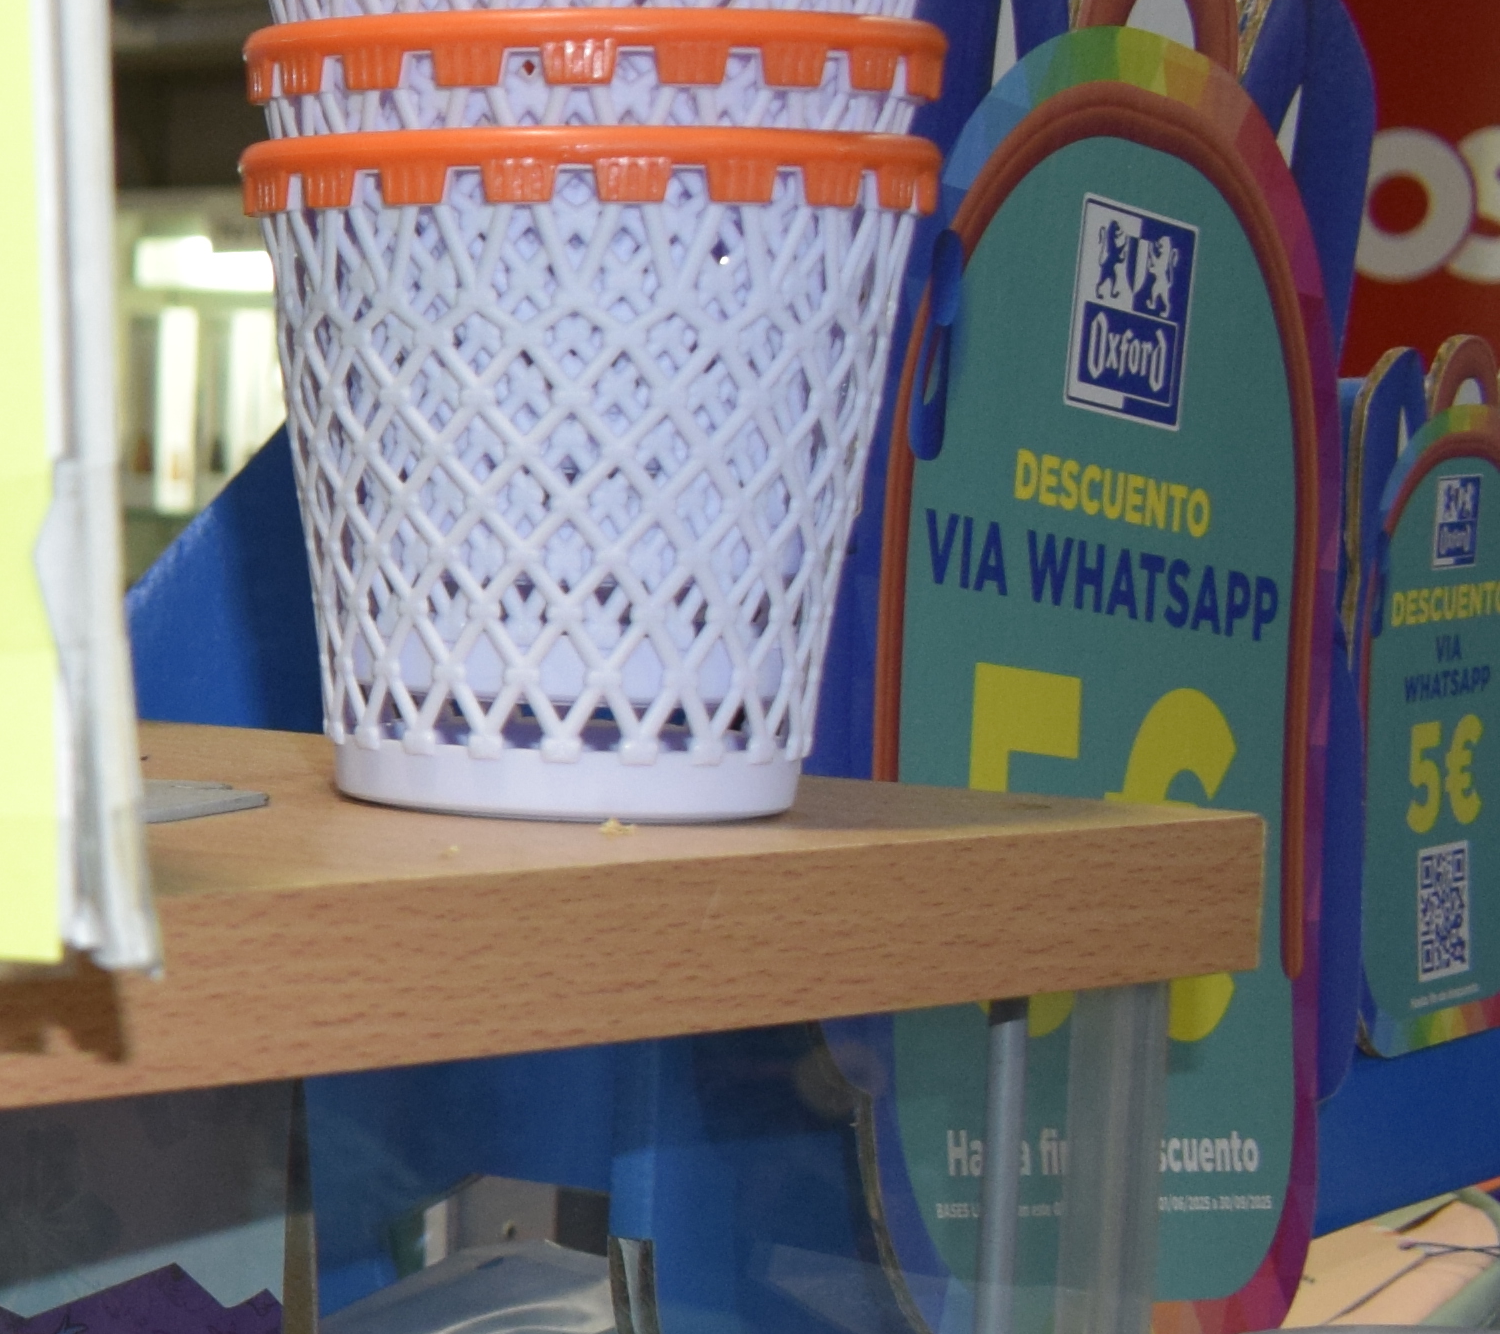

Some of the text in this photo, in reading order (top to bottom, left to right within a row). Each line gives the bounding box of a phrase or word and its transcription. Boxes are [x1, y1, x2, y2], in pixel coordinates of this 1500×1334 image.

[1087, 312, 1167, 392] Oxford
[1013, 447, 1211, 538] DESCUENTO
[925, 507, 1279, 642] VIA WHATSAPP
[1404, 664, 1491, 702] WHATSAPP
[1406, 714, 1484, 834] 5€
